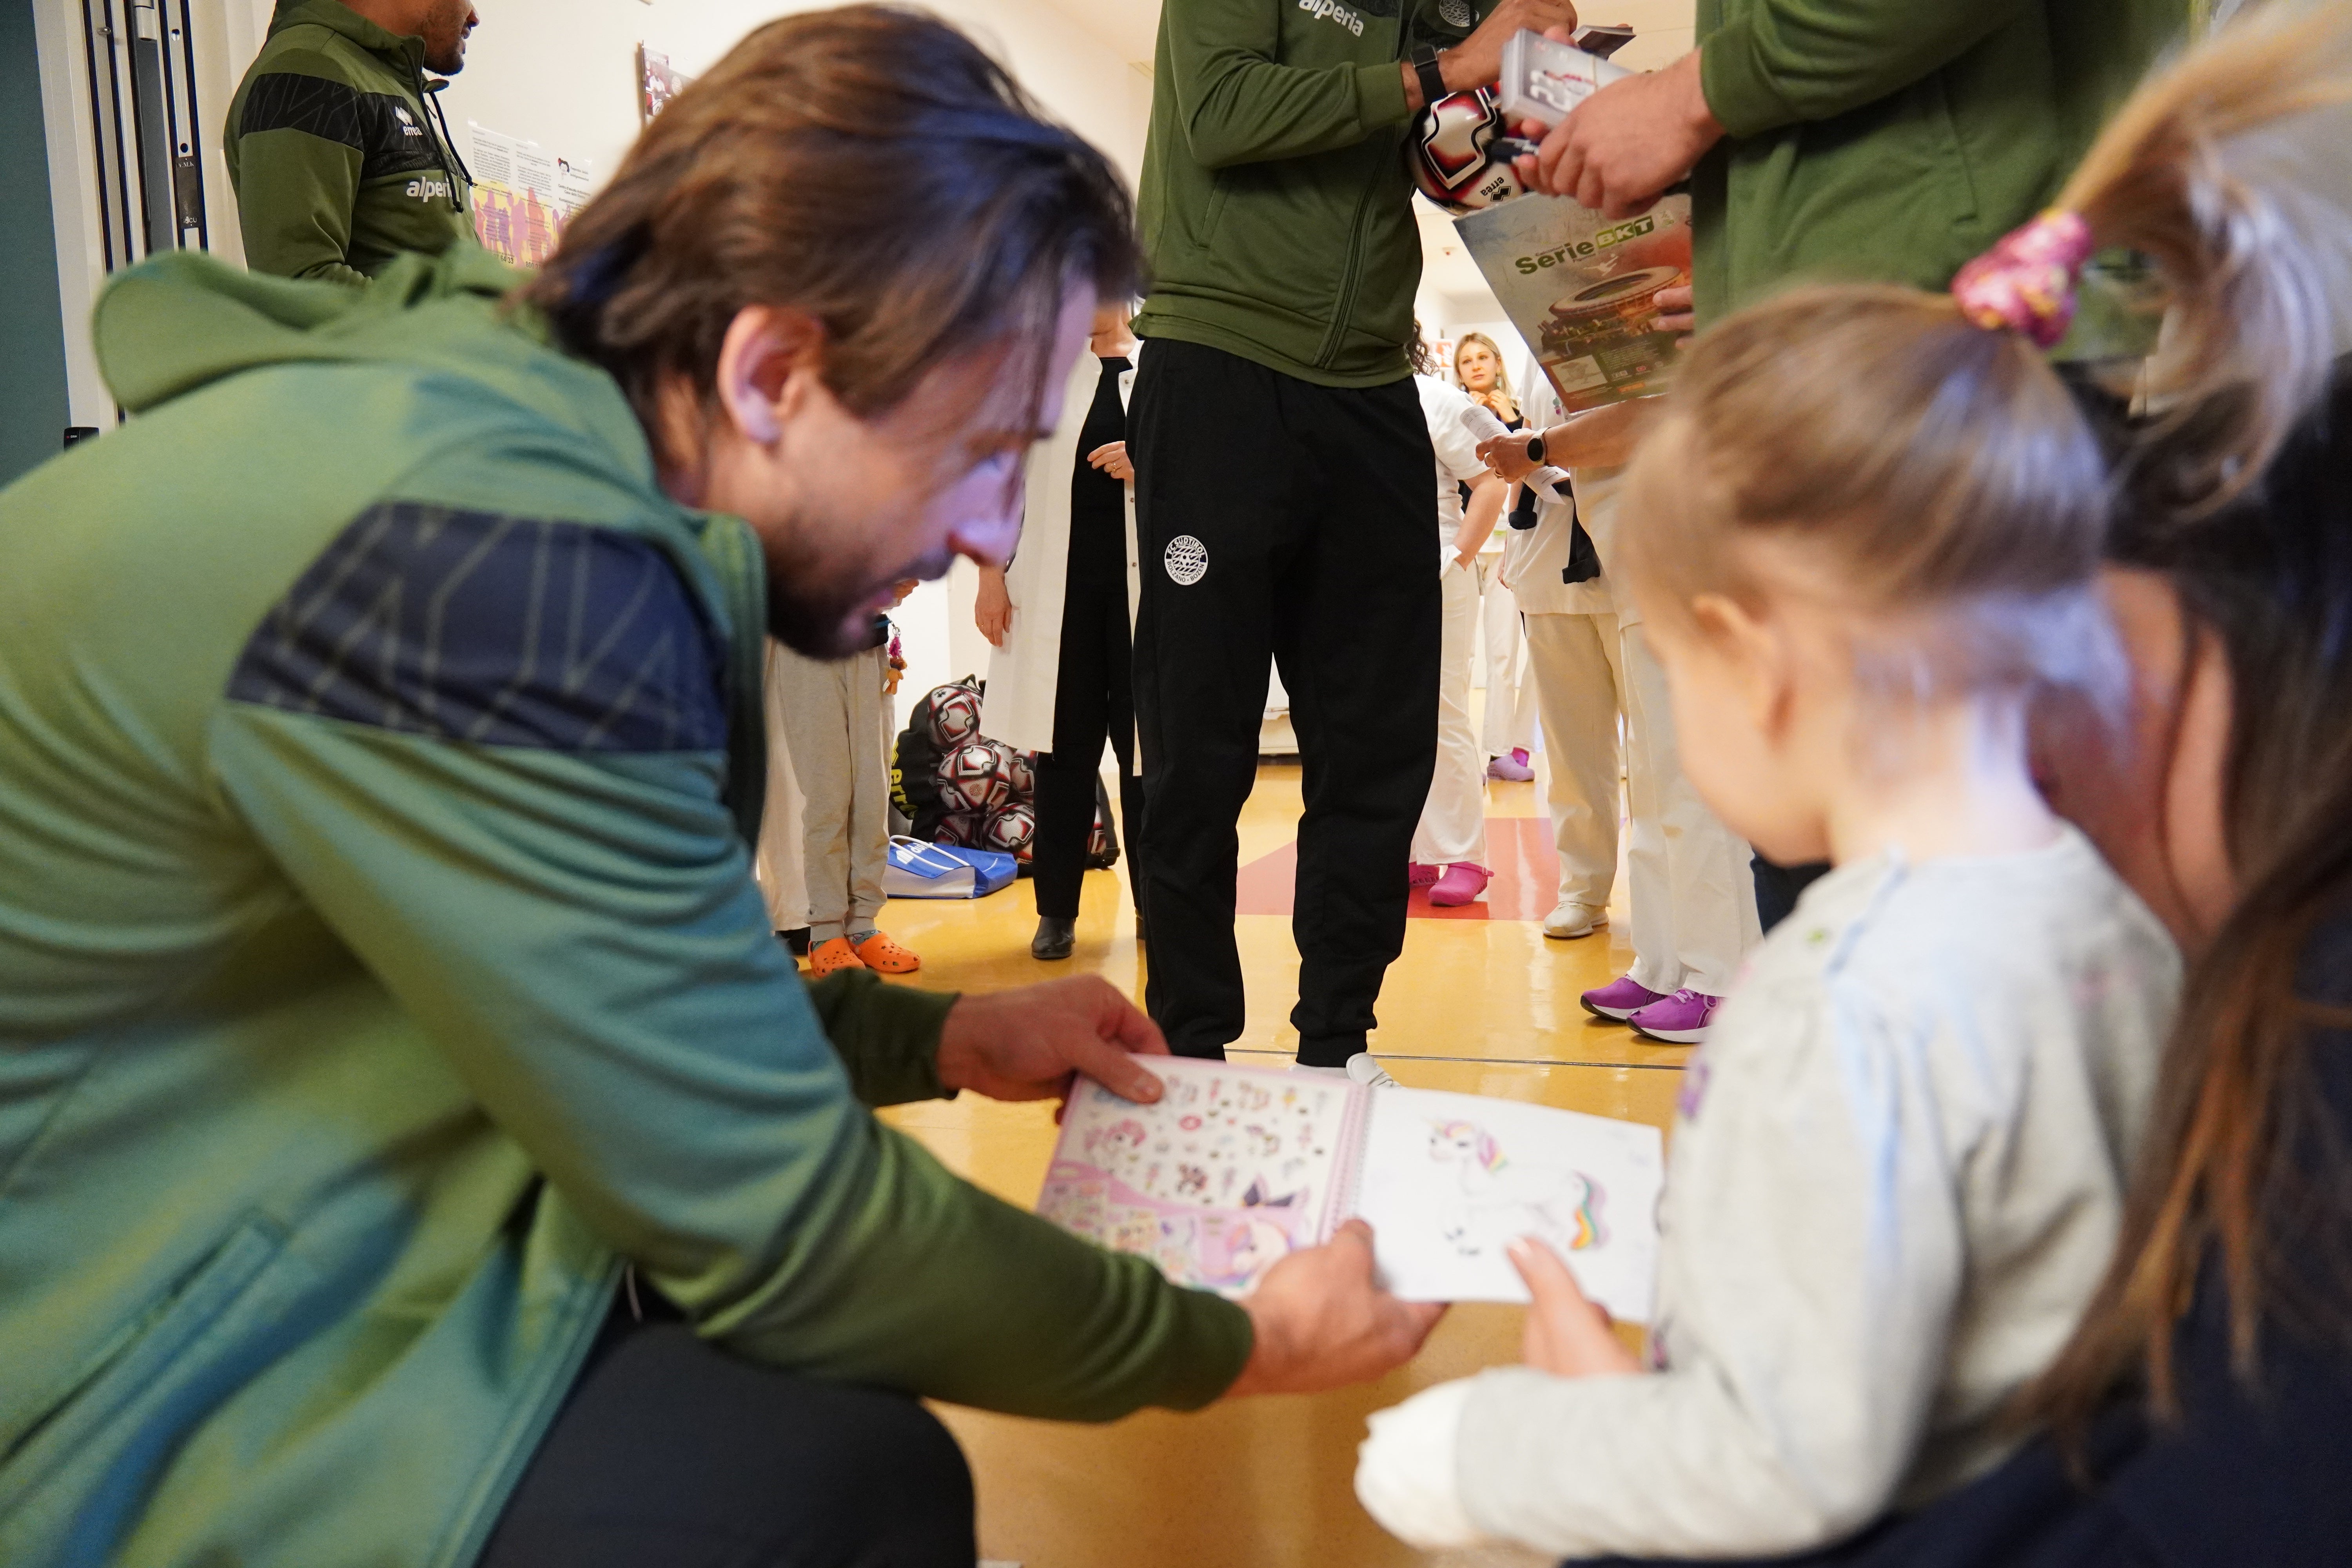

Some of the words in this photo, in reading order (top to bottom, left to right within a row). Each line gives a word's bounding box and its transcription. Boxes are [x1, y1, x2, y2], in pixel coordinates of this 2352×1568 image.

[403, 125, 423, 136] errea
[406, 176, 452, 203] alperi
[1480, 177, 1504, 196] errea
[1515, 242, 1595, 274] Serie
[1597, 217, 1653, 248] BKT
[1167, 544, 1176, 555] FC
[1167, 561, 1186, 583] BOLZANO
[1190, 563, 1205, 581] BOZEN
